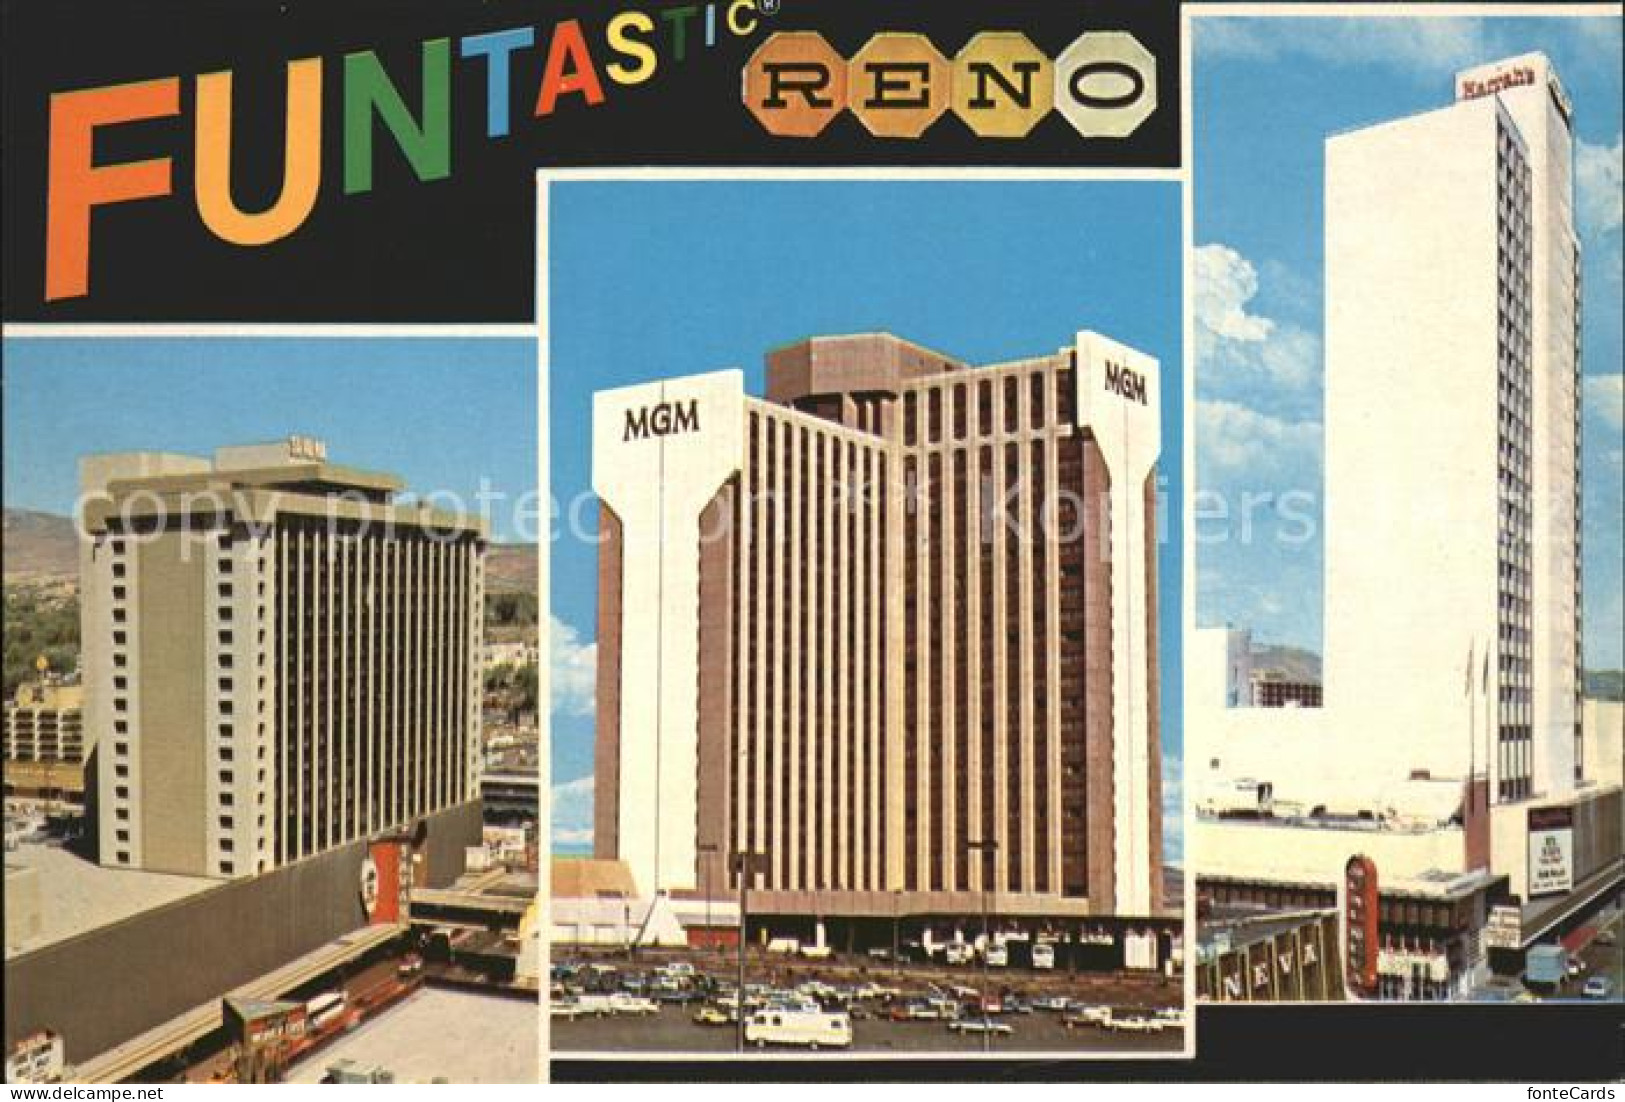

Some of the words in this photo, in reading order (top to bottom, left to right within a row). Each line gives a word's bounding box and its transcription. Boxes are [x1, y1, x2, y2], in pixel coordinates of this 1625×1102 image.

[761, 62, 1145, 108] RENO
[1105, 359, 1148, 406] MGM
[622, 398, 700, 442] MGM
